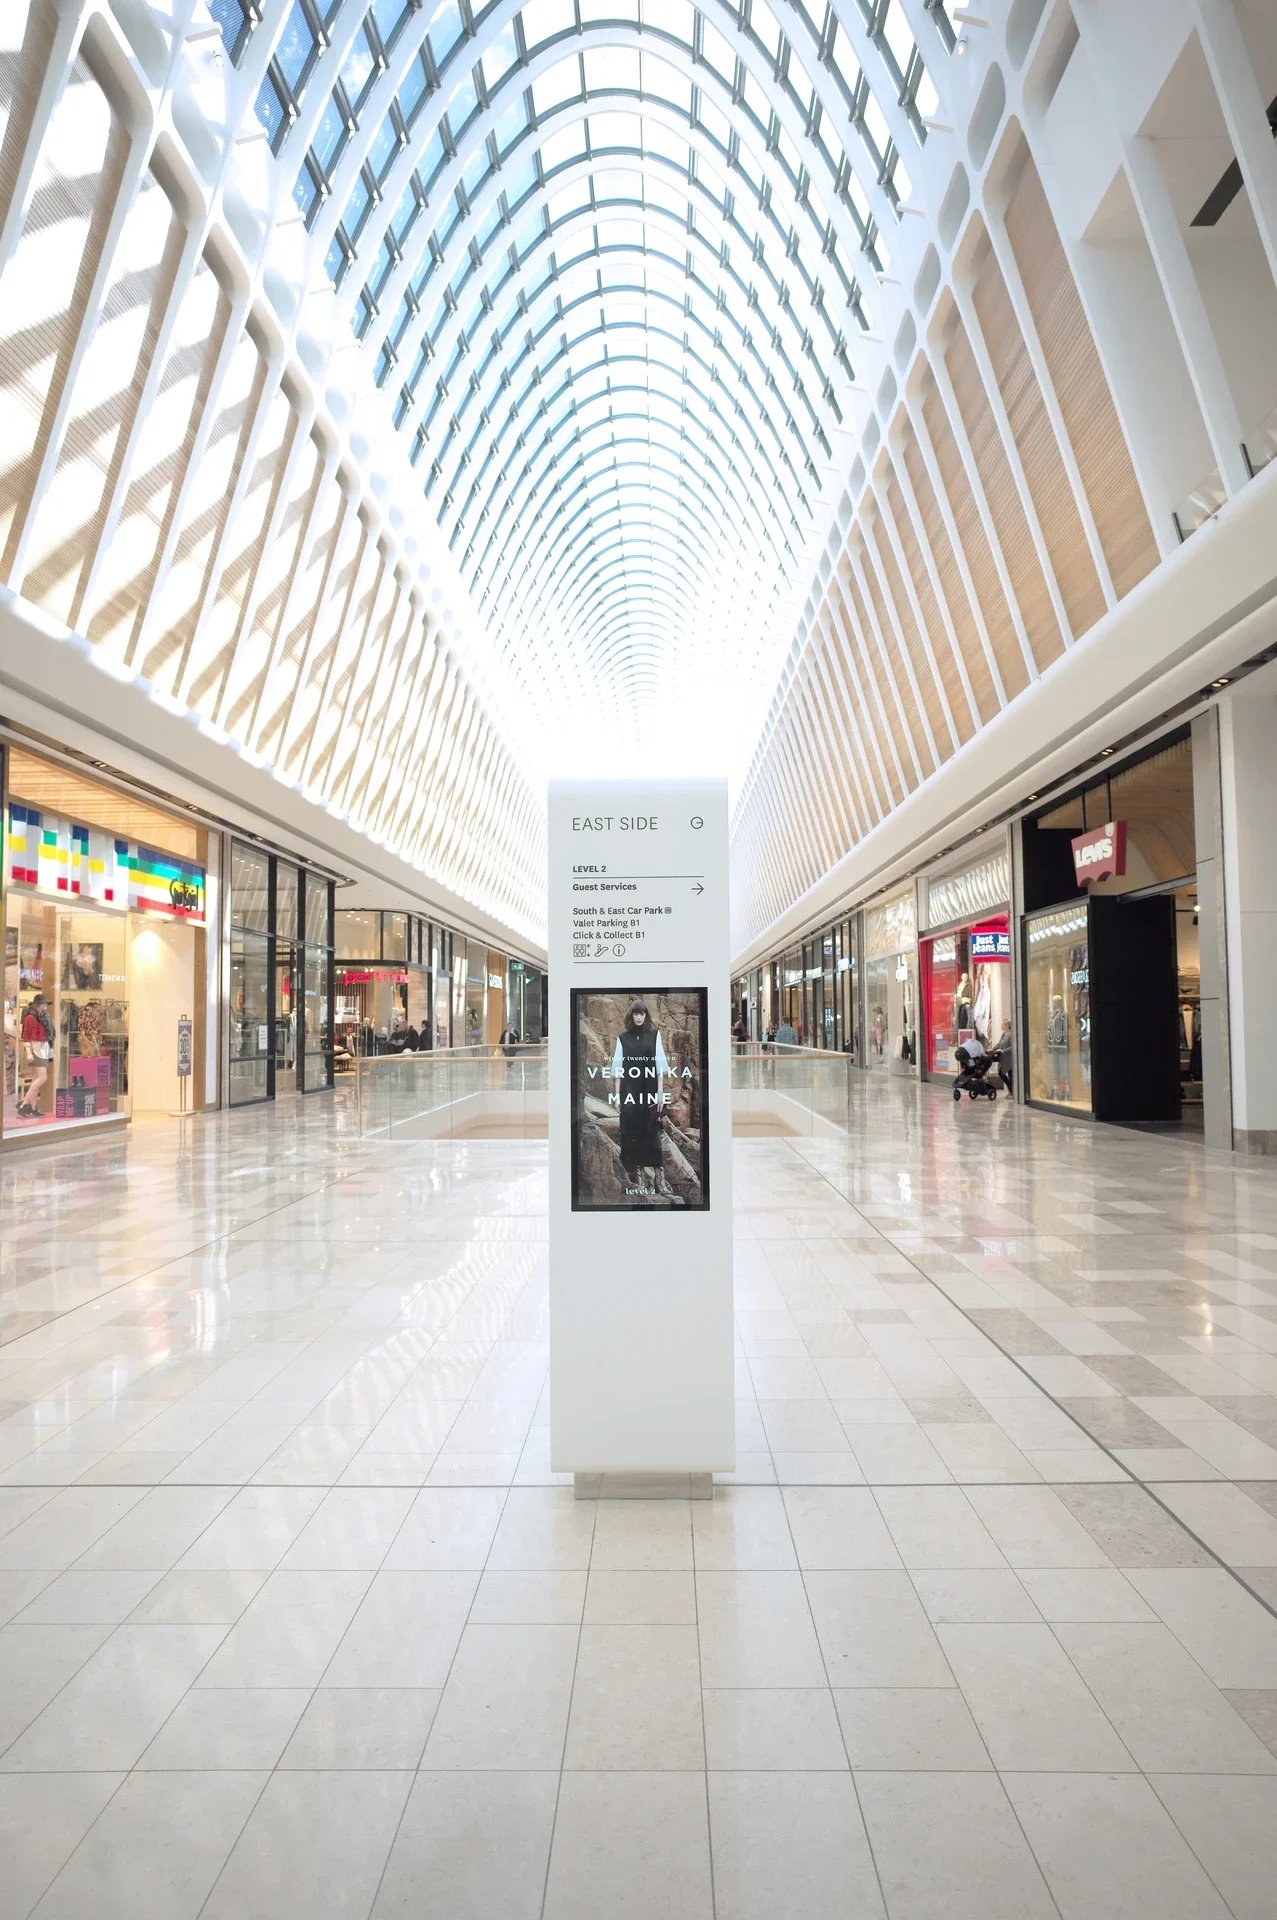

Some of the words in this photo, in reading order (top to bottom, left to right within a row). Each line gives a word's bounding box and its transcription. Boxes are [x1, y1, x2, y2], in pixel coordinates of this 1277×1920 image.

[572, 817, 615, 831] EAST
[619, 816, 658, 831] SIDE
[572, 865, 599, 873] LEVEL
[601, 865, 607, 873] 2
[572, 883, 599, 891] Guest
[600, 882, 638, 891] Services
[573, 906, 598, 915] South
[599, 907, 606, 915] &
[607, 907, 626, 915] East
[627, 906, 643, 915] Car
[644, 905, 664, 915] Park
[573, 919, 595, 927] Valet
[596, 918, 629, 929] Parking
[630, 919, 641, 927] B1
[572, 931, 594, 939] Click
[595, 931, 602, 939] &
[603, 931, 634, 939] Collect
[635, 931, 645, 939] B1
[587, 1066, 693, 1079] VERONIKA
[608, 1092, 672, 1105] MAINE
[625, 1187, 648, 1195] level
